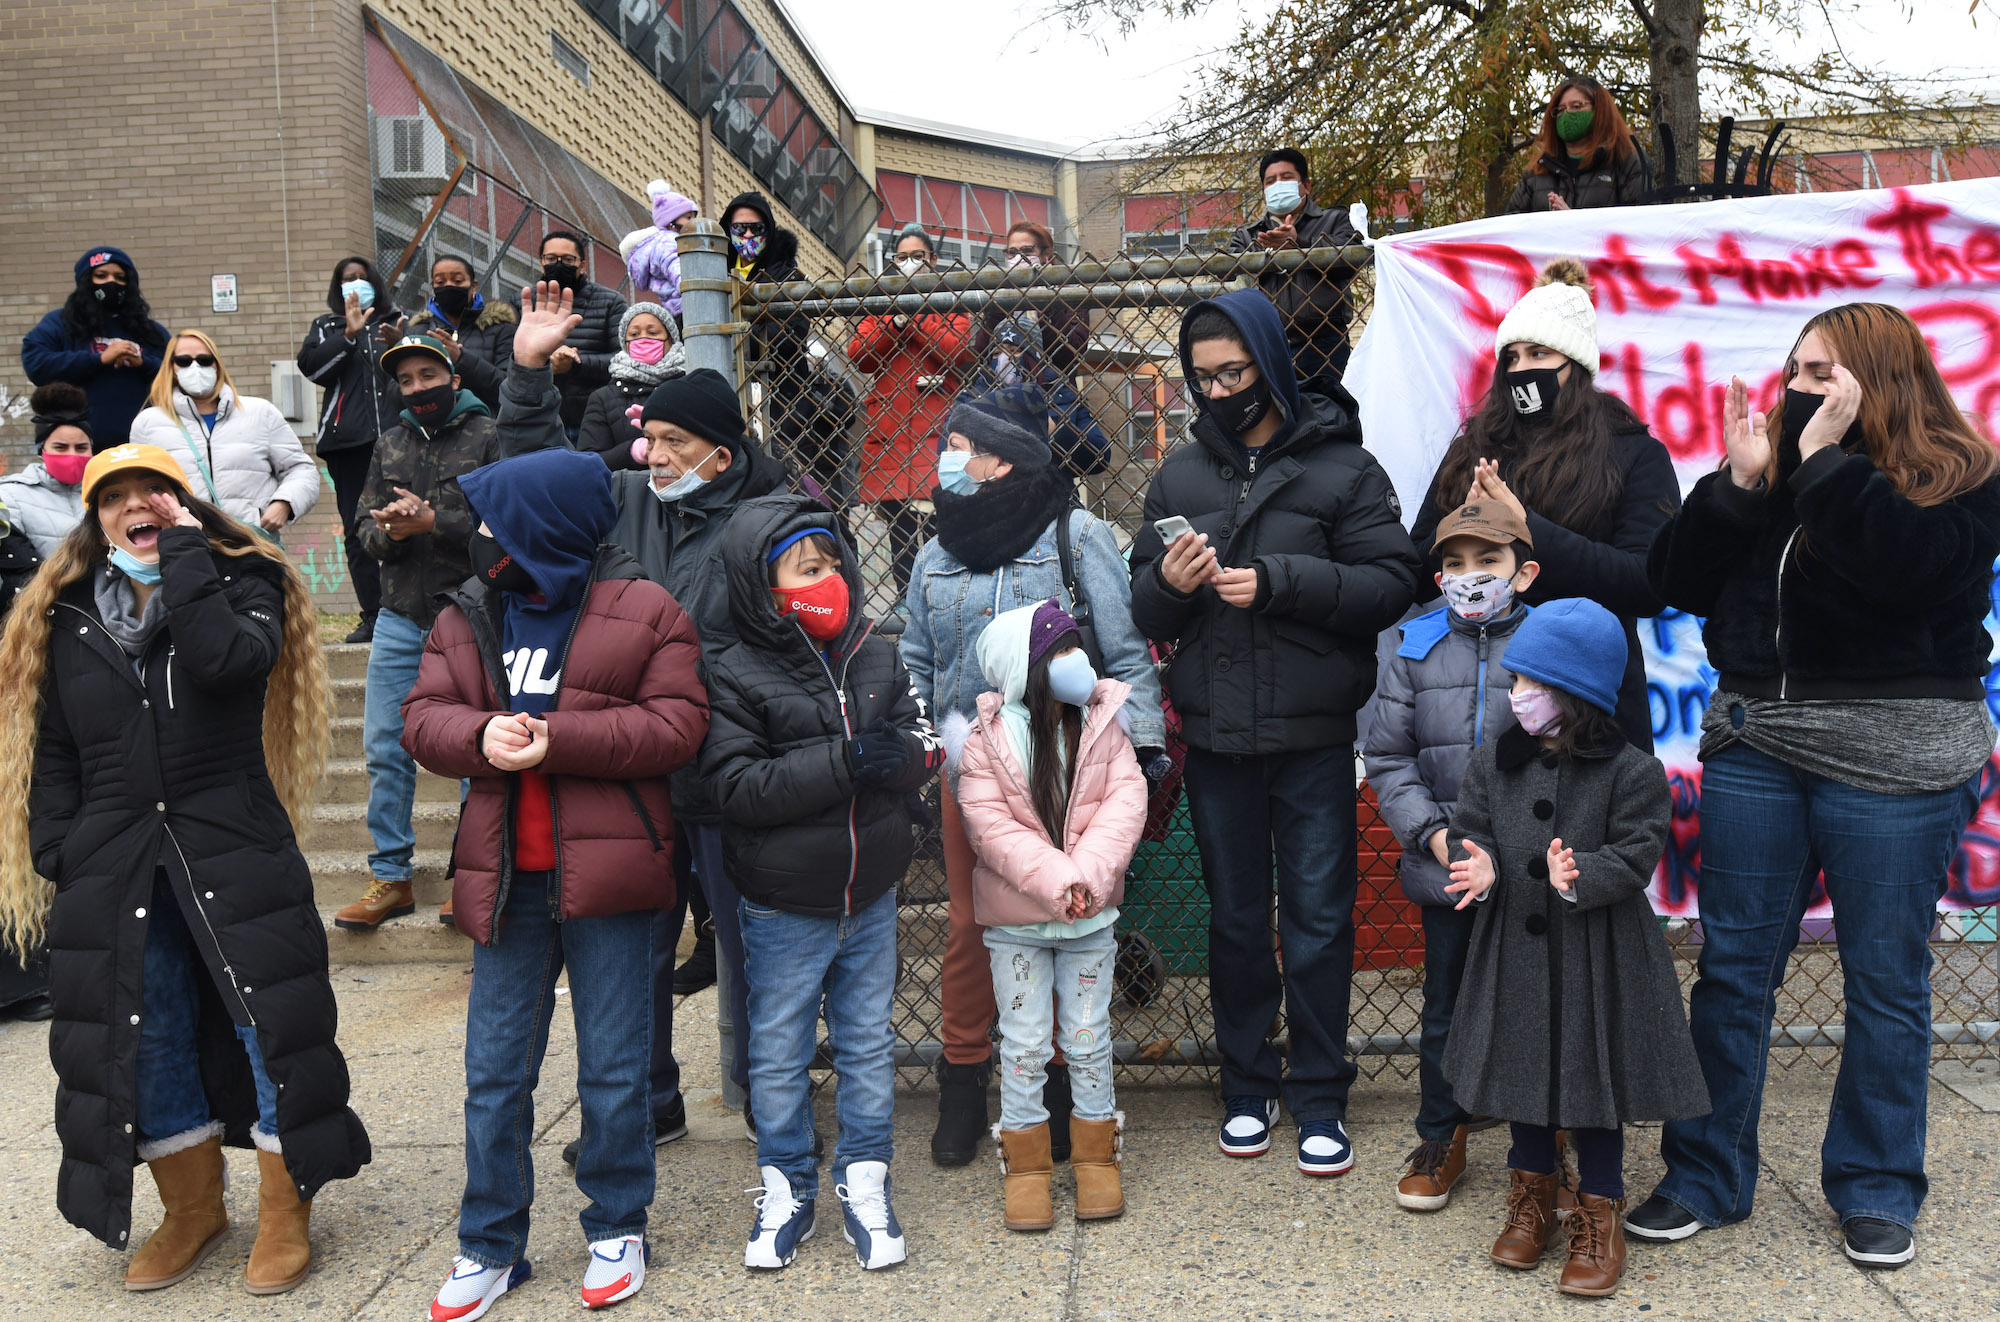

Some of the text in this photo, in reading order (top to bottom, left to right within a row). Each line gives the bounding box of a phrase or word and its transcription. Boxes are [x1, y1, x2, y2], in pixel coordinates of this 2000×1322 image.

[493, 555, 512, 573] Coop
[801, 602, 833, 615] Cooper
[251, 611, 270, 620] DKNY
